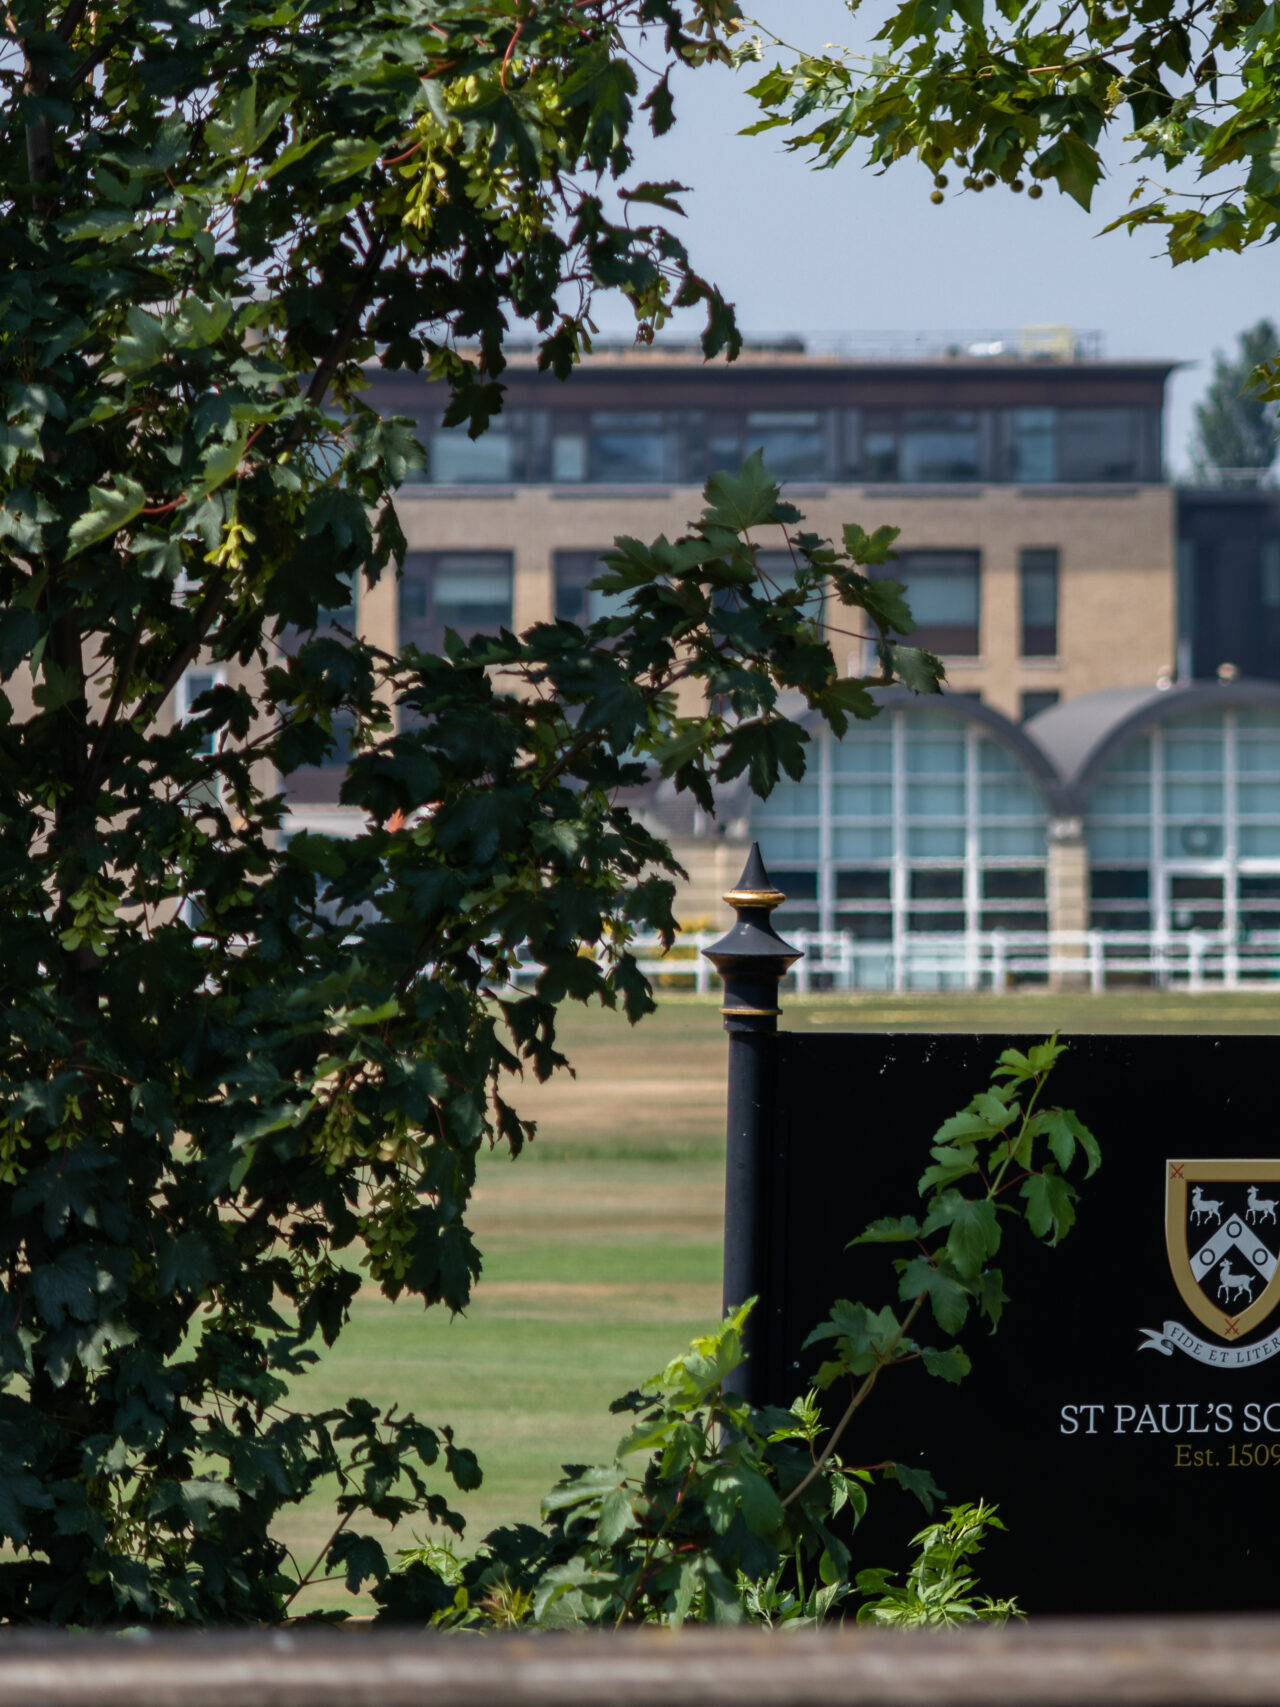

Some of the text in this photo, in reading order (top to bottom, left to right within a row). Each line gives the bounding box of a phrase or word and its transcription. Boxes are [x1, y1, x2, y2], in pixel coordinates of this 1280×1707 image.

[1171, 1326, 1201, 1355] FIDE
[1209, 1350, 1229, 1363] ET
[1060, 1404, 1105, 1434] ST
[1113, 1402, 1233, 1433] PAUL’S
[1175, 1445, 1219, 1467] Est.
